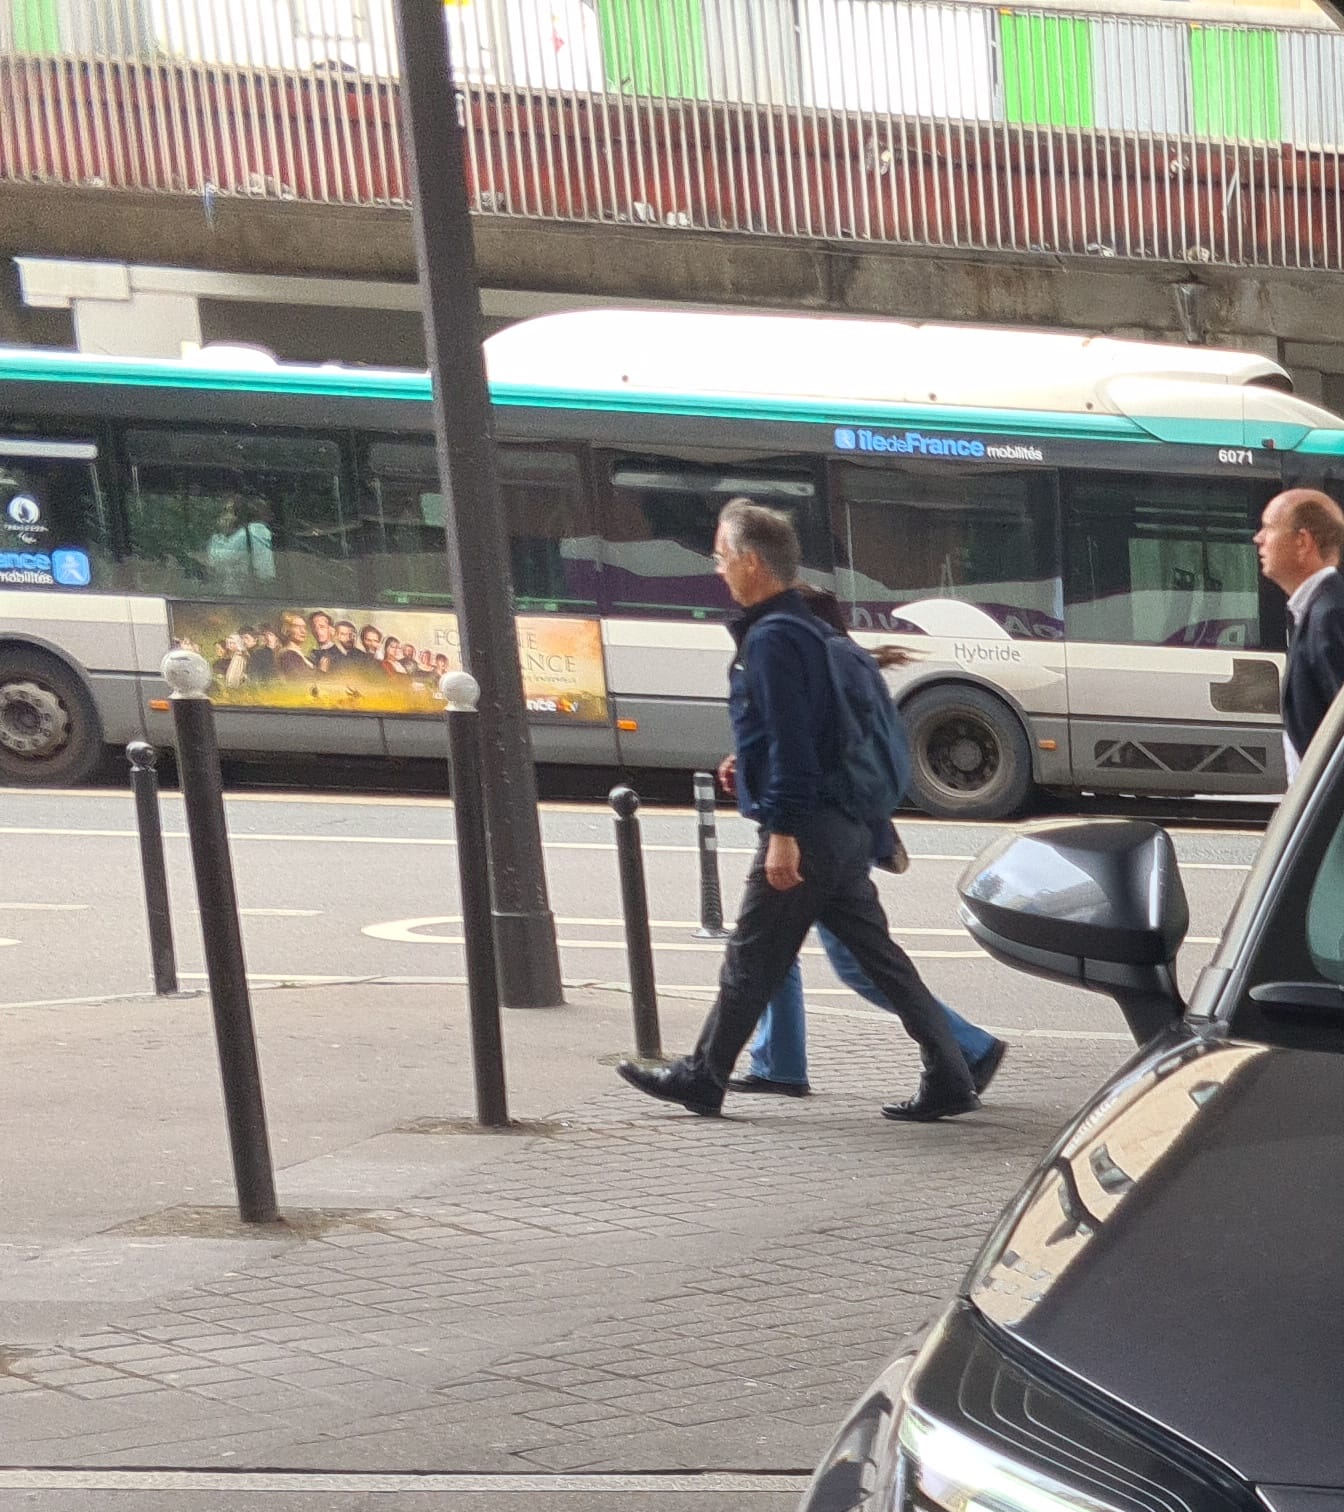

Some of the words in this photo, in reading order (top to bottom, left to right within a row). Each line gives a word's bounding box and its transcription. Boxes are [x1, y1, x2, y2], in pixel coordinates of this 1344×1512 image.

[986, 444, 1043, 462] mobilités
[1218, 449, 1253, 465] 6071
[954, 642, 1022, 663] Hybride
